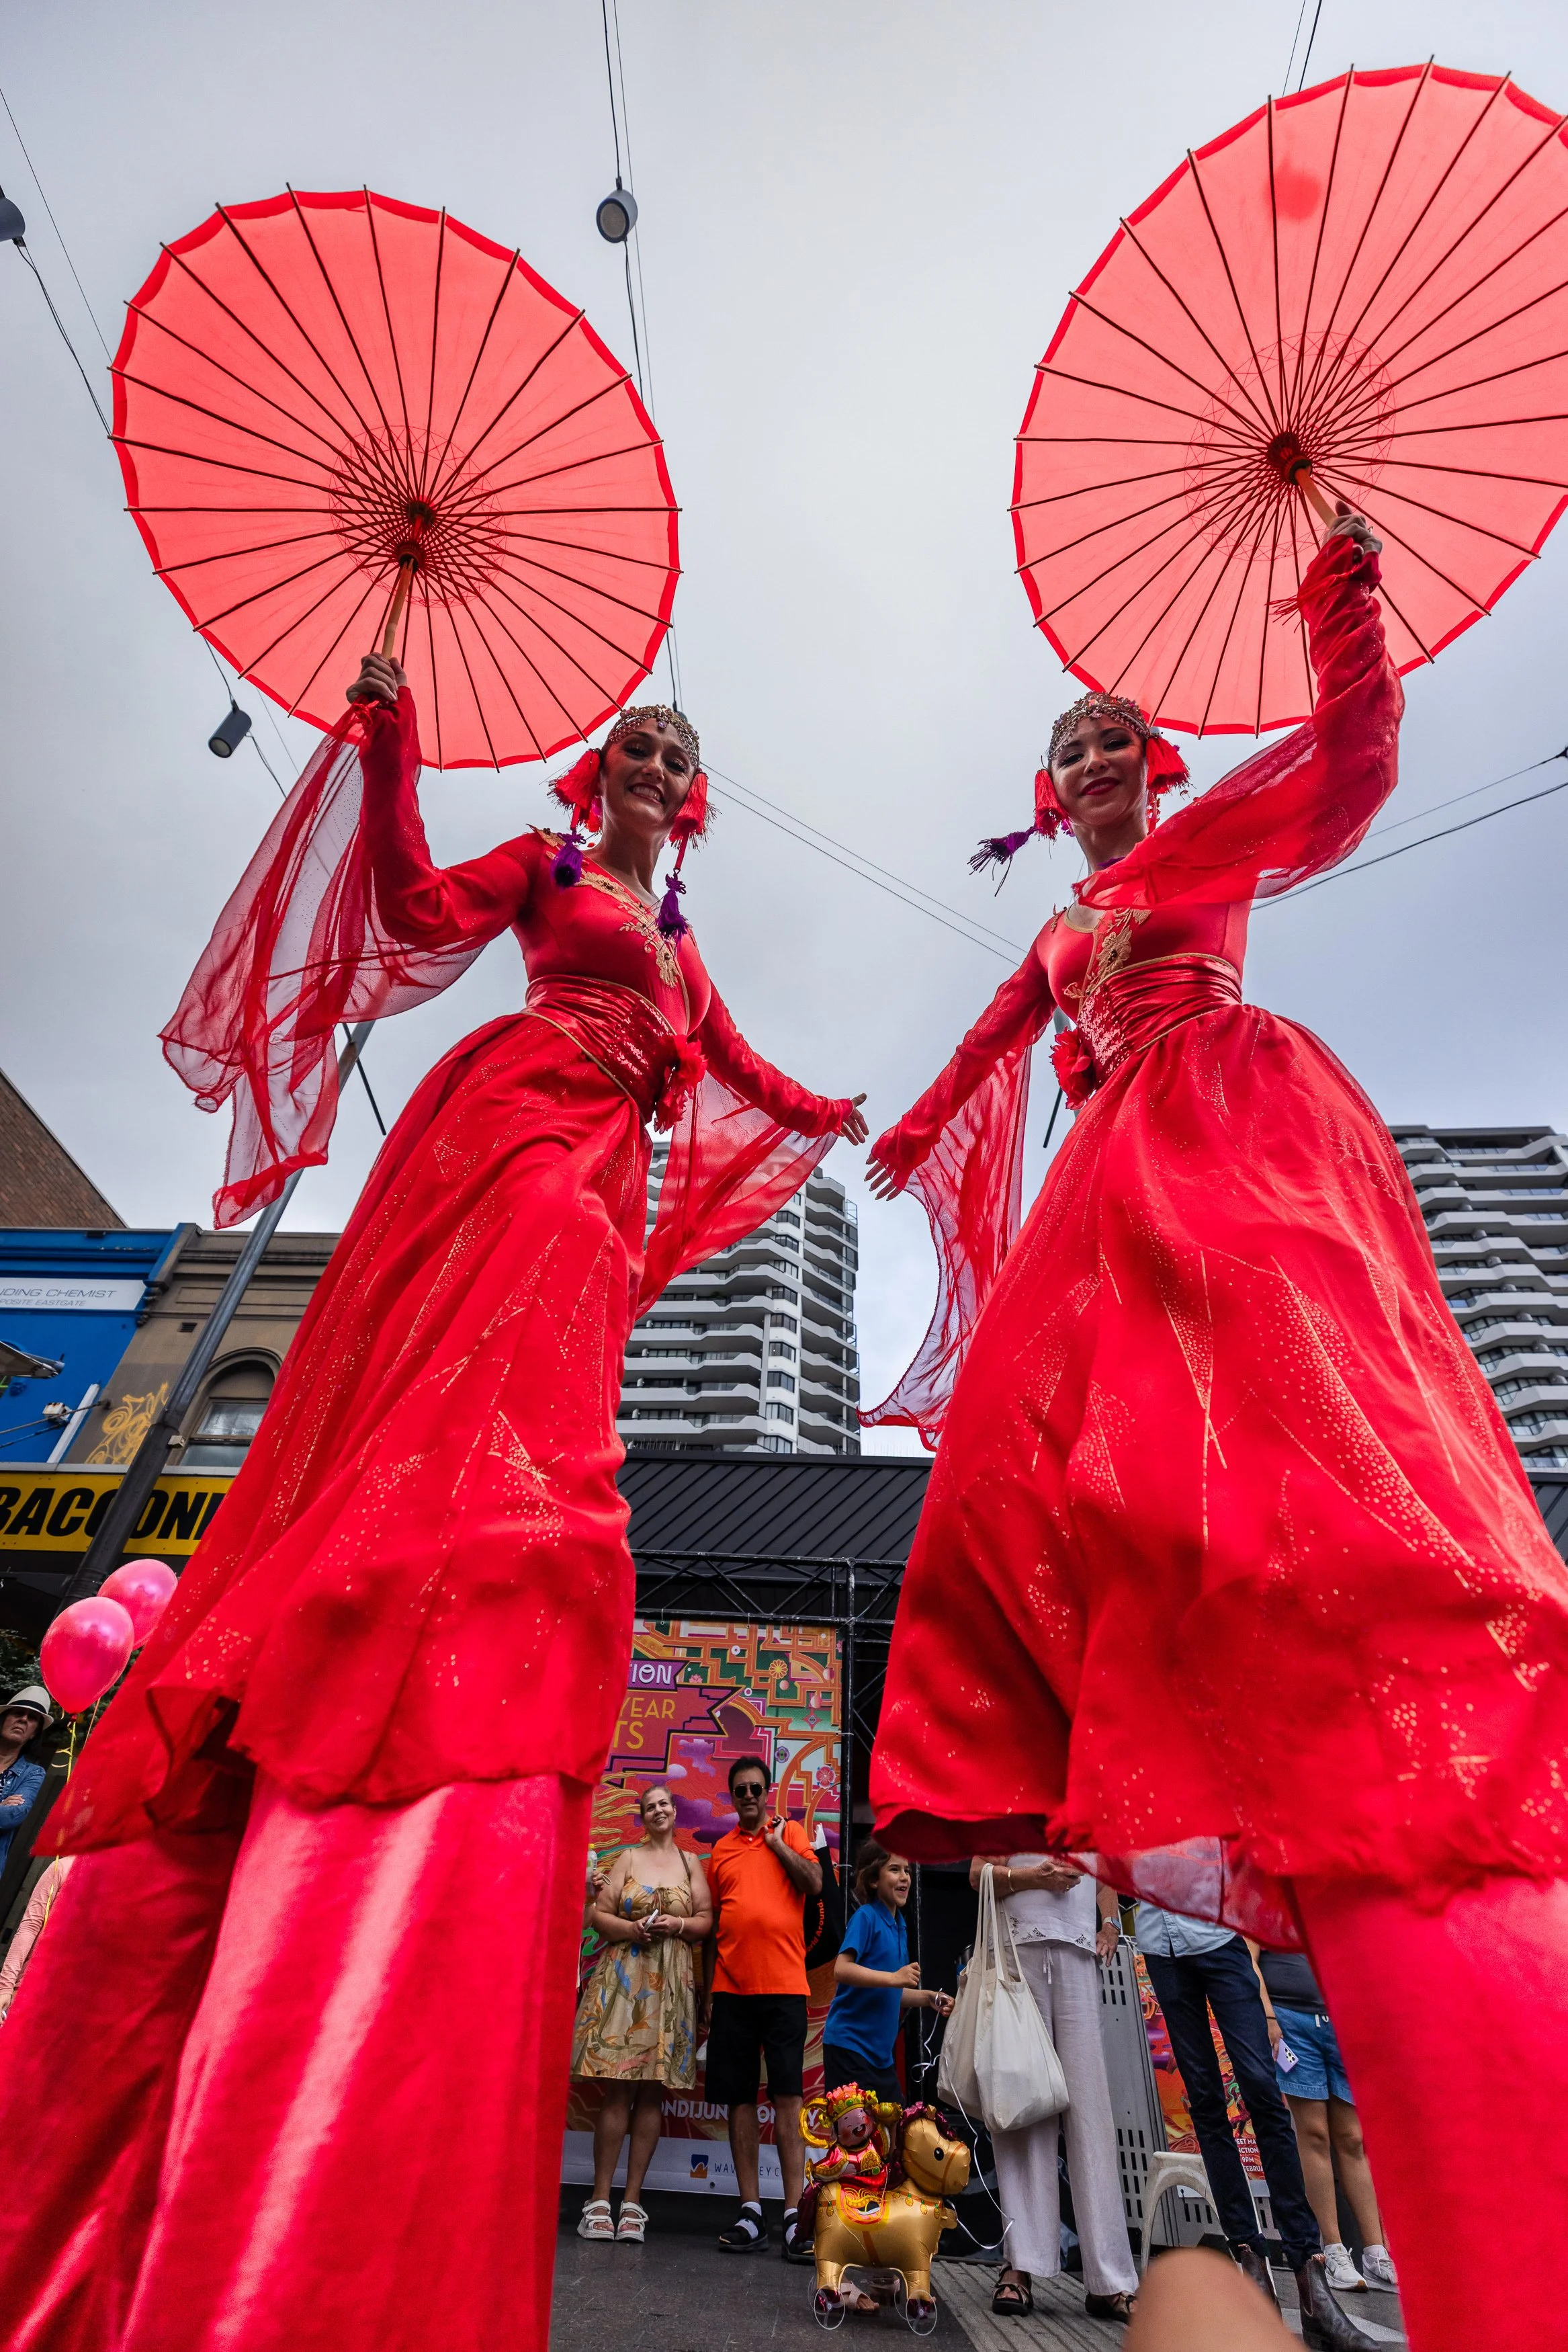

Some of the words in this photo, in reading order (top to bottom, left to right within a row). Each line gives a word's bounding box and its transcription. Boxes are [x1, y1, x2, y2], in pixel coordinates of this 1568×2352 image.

[46, 1289, 117, 1298] CHEMIST
[630, 1663, 672, 1684] ION
[816, 1899, 824, 1937] Around.
